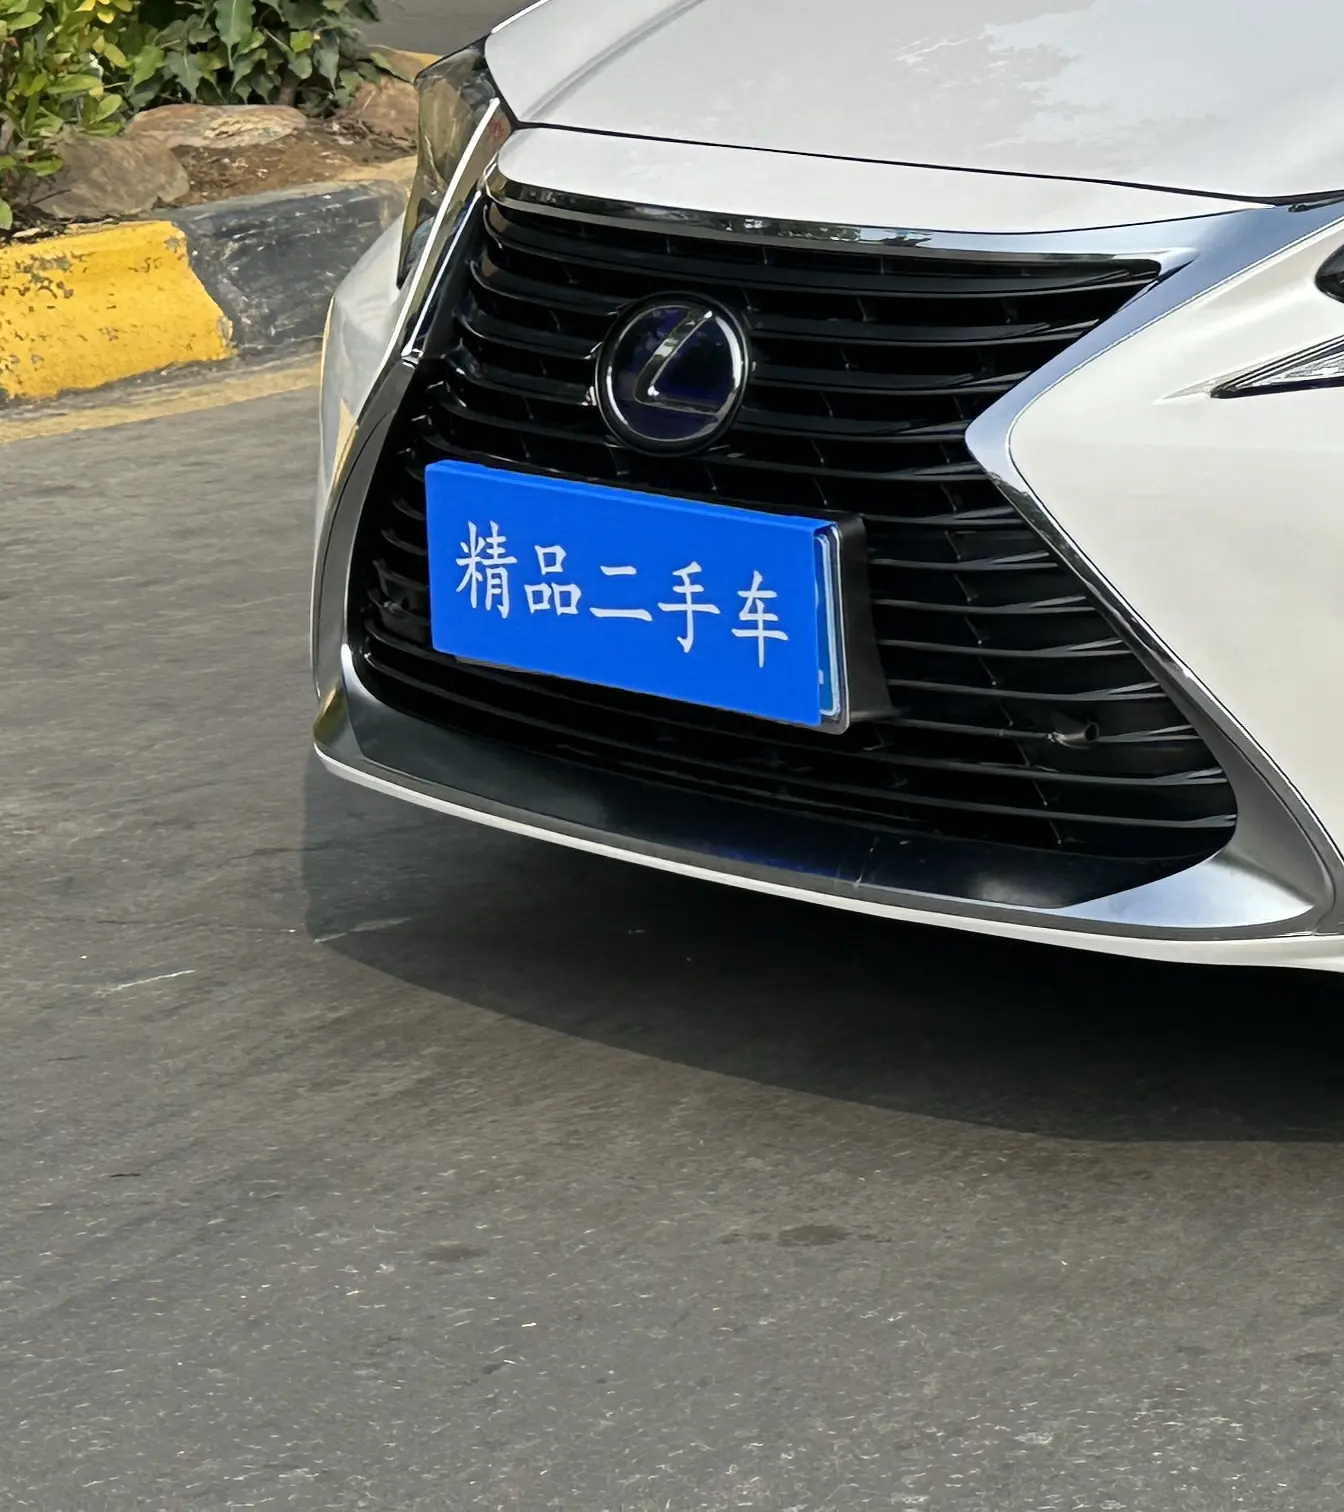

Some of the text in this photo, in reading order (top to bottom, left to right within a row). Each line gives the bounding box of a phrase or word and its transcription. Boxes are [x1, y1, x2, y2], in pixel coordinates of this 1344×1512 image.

[455, 520, 789, 668] 精品二手车
